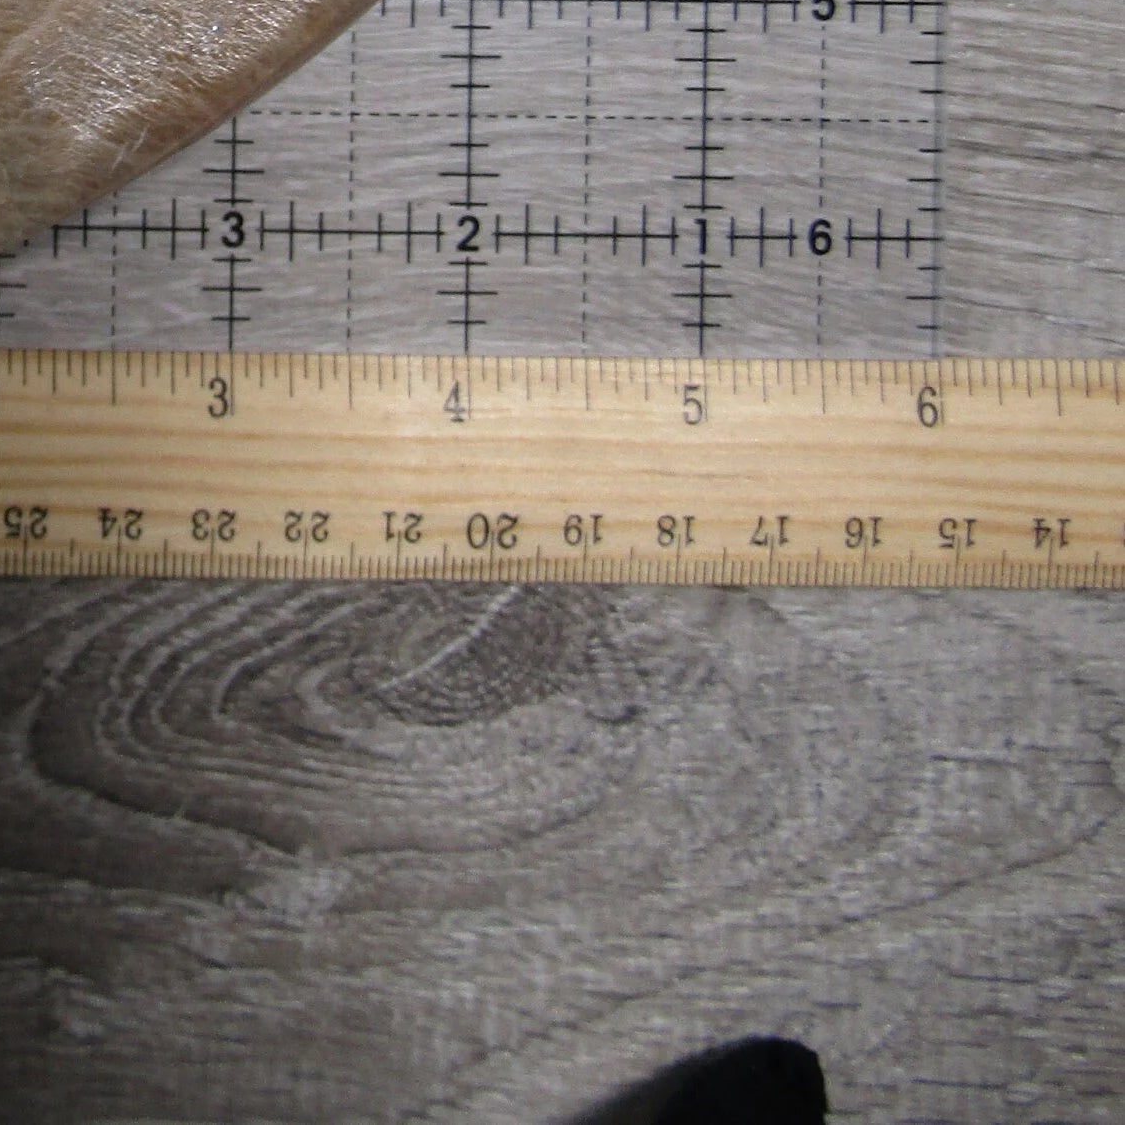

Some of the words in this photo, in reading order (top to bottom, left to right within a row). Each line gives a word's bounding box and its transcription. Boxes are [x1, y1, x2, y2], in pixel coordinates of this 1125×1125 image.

[221, 210, 246, 248] 3
[456, 215, 480, 253] 2
[695, 217, 709, 254] 1
[807, 219, 832, 257] 6
[207, 377, 230, 419] 3
[442, 380, 466, 423] 4
[682, 384, 704, 426] 5
[917, 385, 939, 428] 6
[3, 505, 49, 540] 25
[97, 507, 145, 541] 24
[190, 508, 236, 542] 23
[284, 510, 331, 543] 22
[382, 510, 425, 544] 21
[466, 512, 520, 550] 20
[563, 513, 605, 546] 19
[657, 514, 697, 547] 18
[750, 515, 790, 547] 17
[844, 516, 884, 549] 16
[938, 517, 978, 549] 15
[1032, 517, 1072, 550] 14
